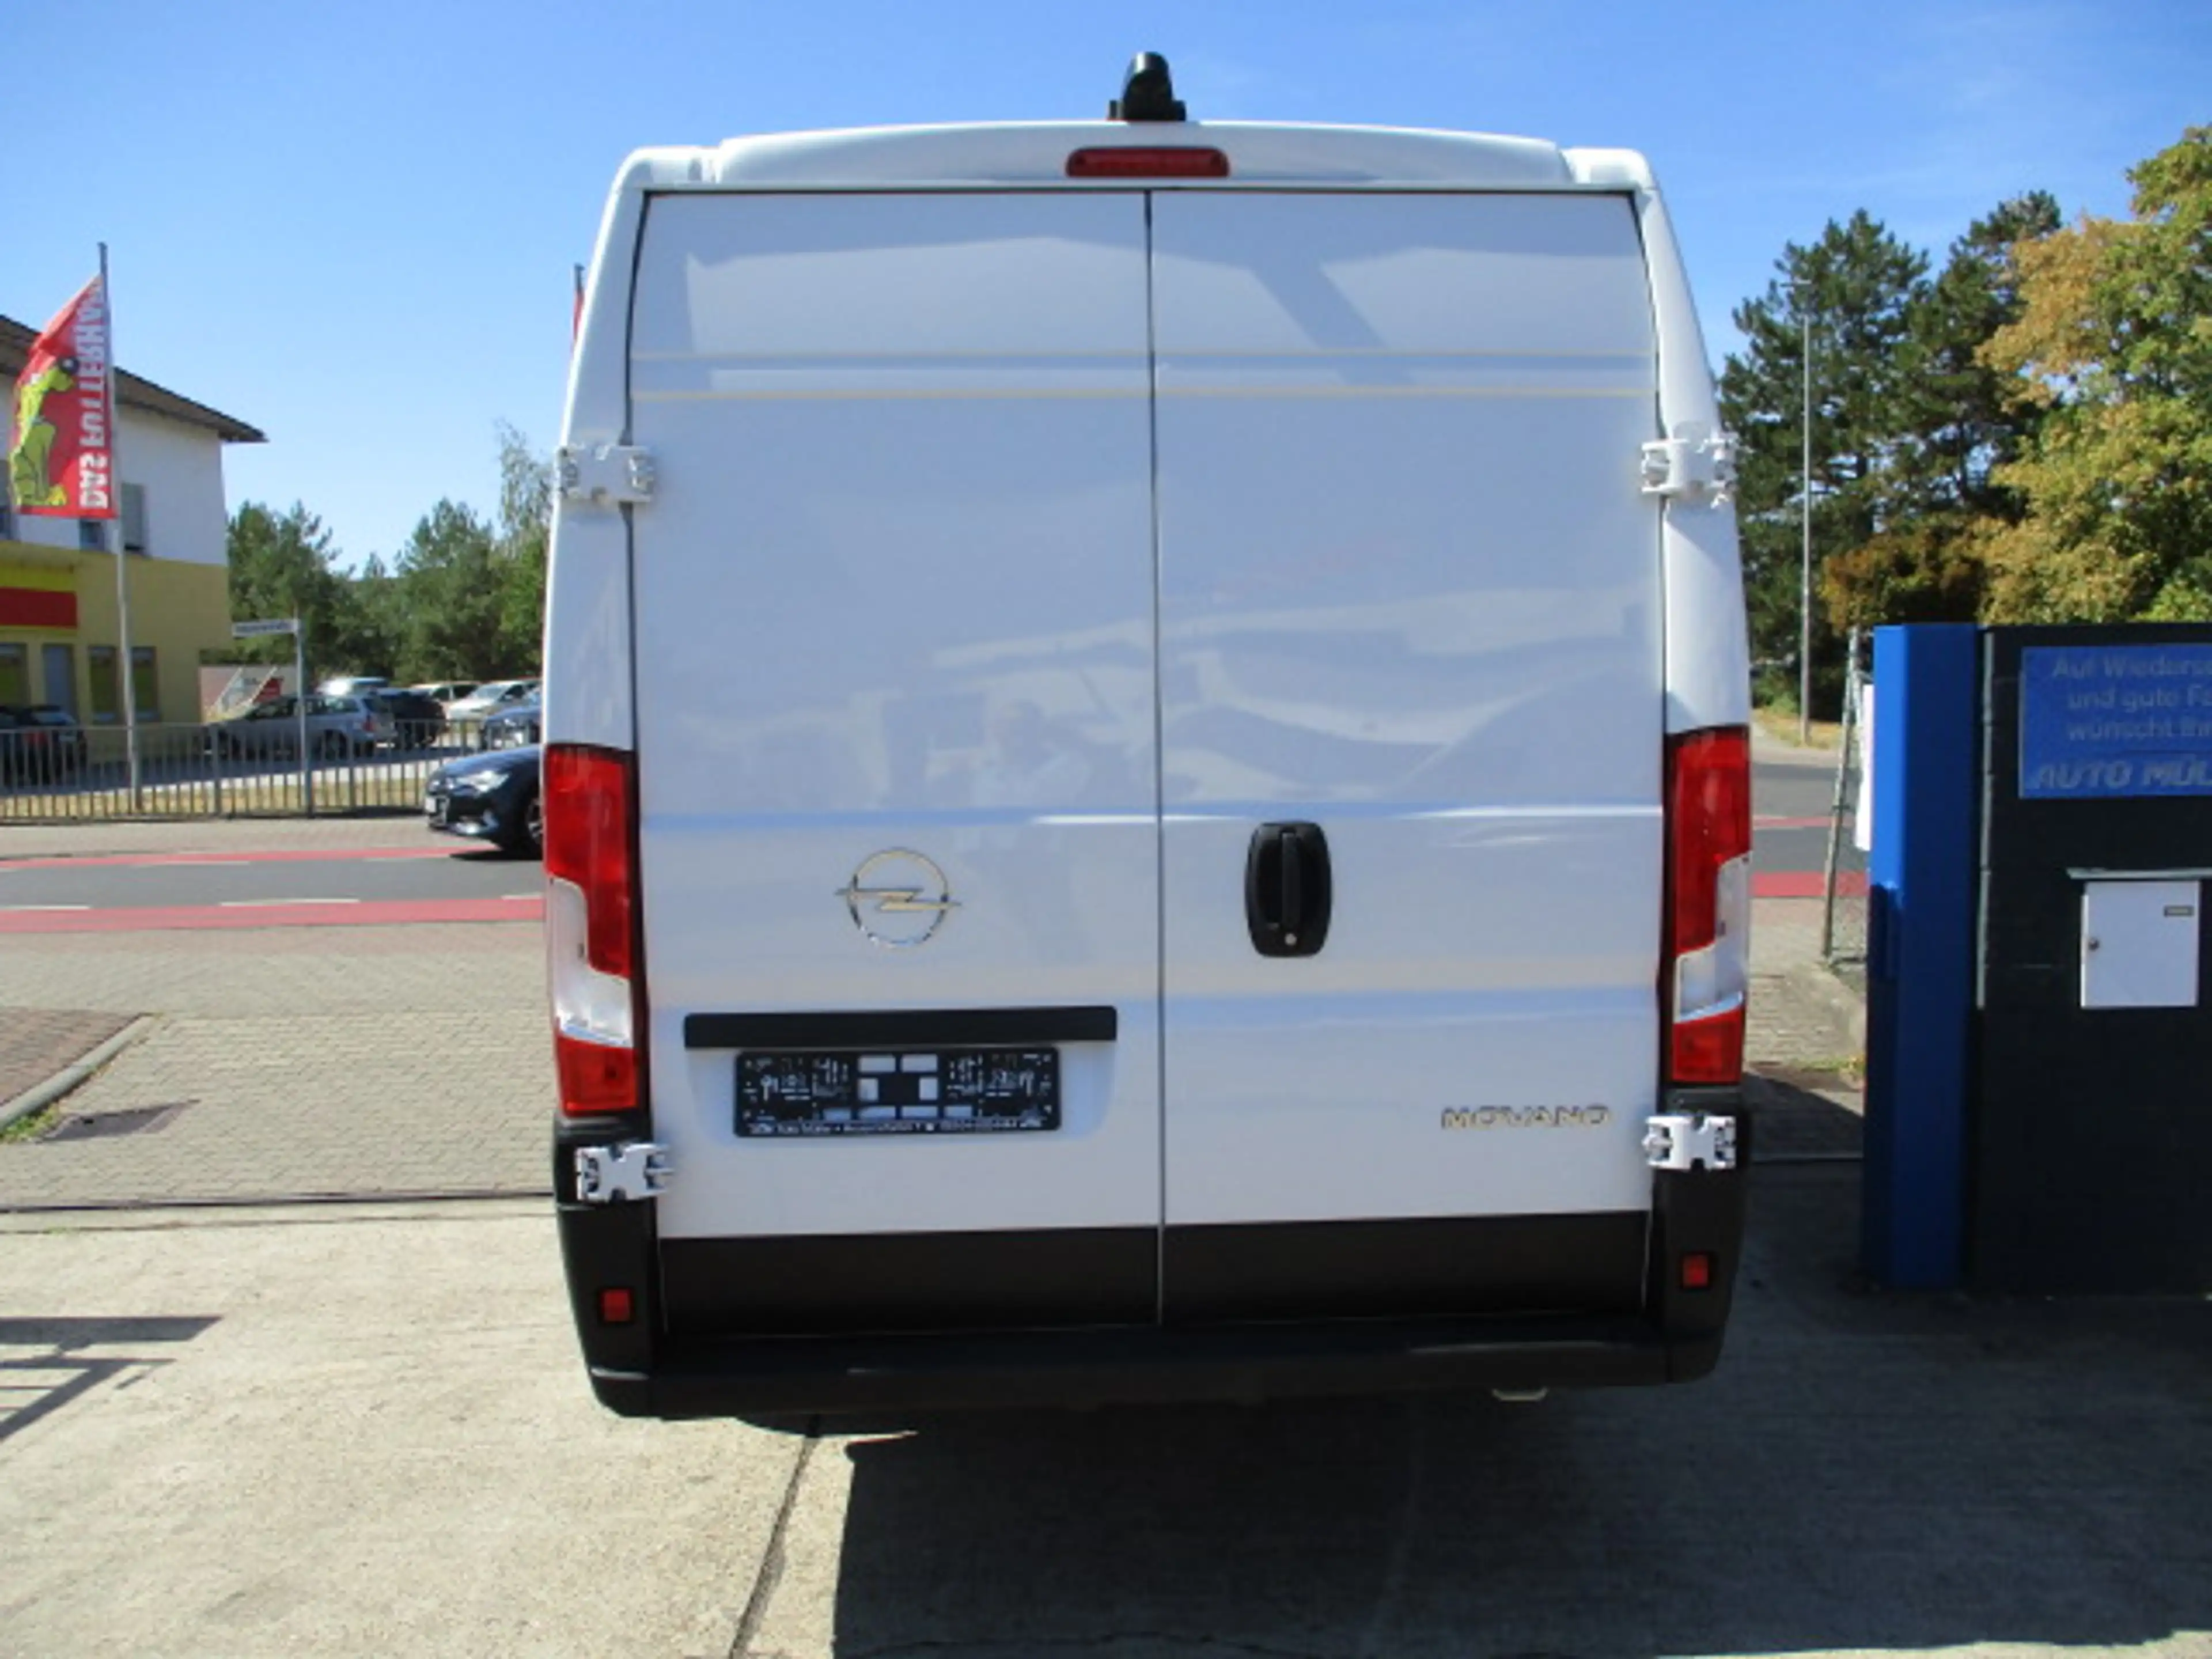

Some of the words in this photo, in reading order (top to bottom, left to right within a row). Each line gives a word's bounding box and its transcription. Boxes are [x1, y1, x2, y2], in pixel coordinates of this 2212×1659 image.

[2052, 656, 2095, 679] Auf
[2067, 687, 2116, 710] und
[2121, 687, 2180, 713] gute
[2067, 715, 2173, 741] wünscht
[2037, 759, 2133, 789] AUTO
[1441, 1104, 1611, 1130] MOVANO
